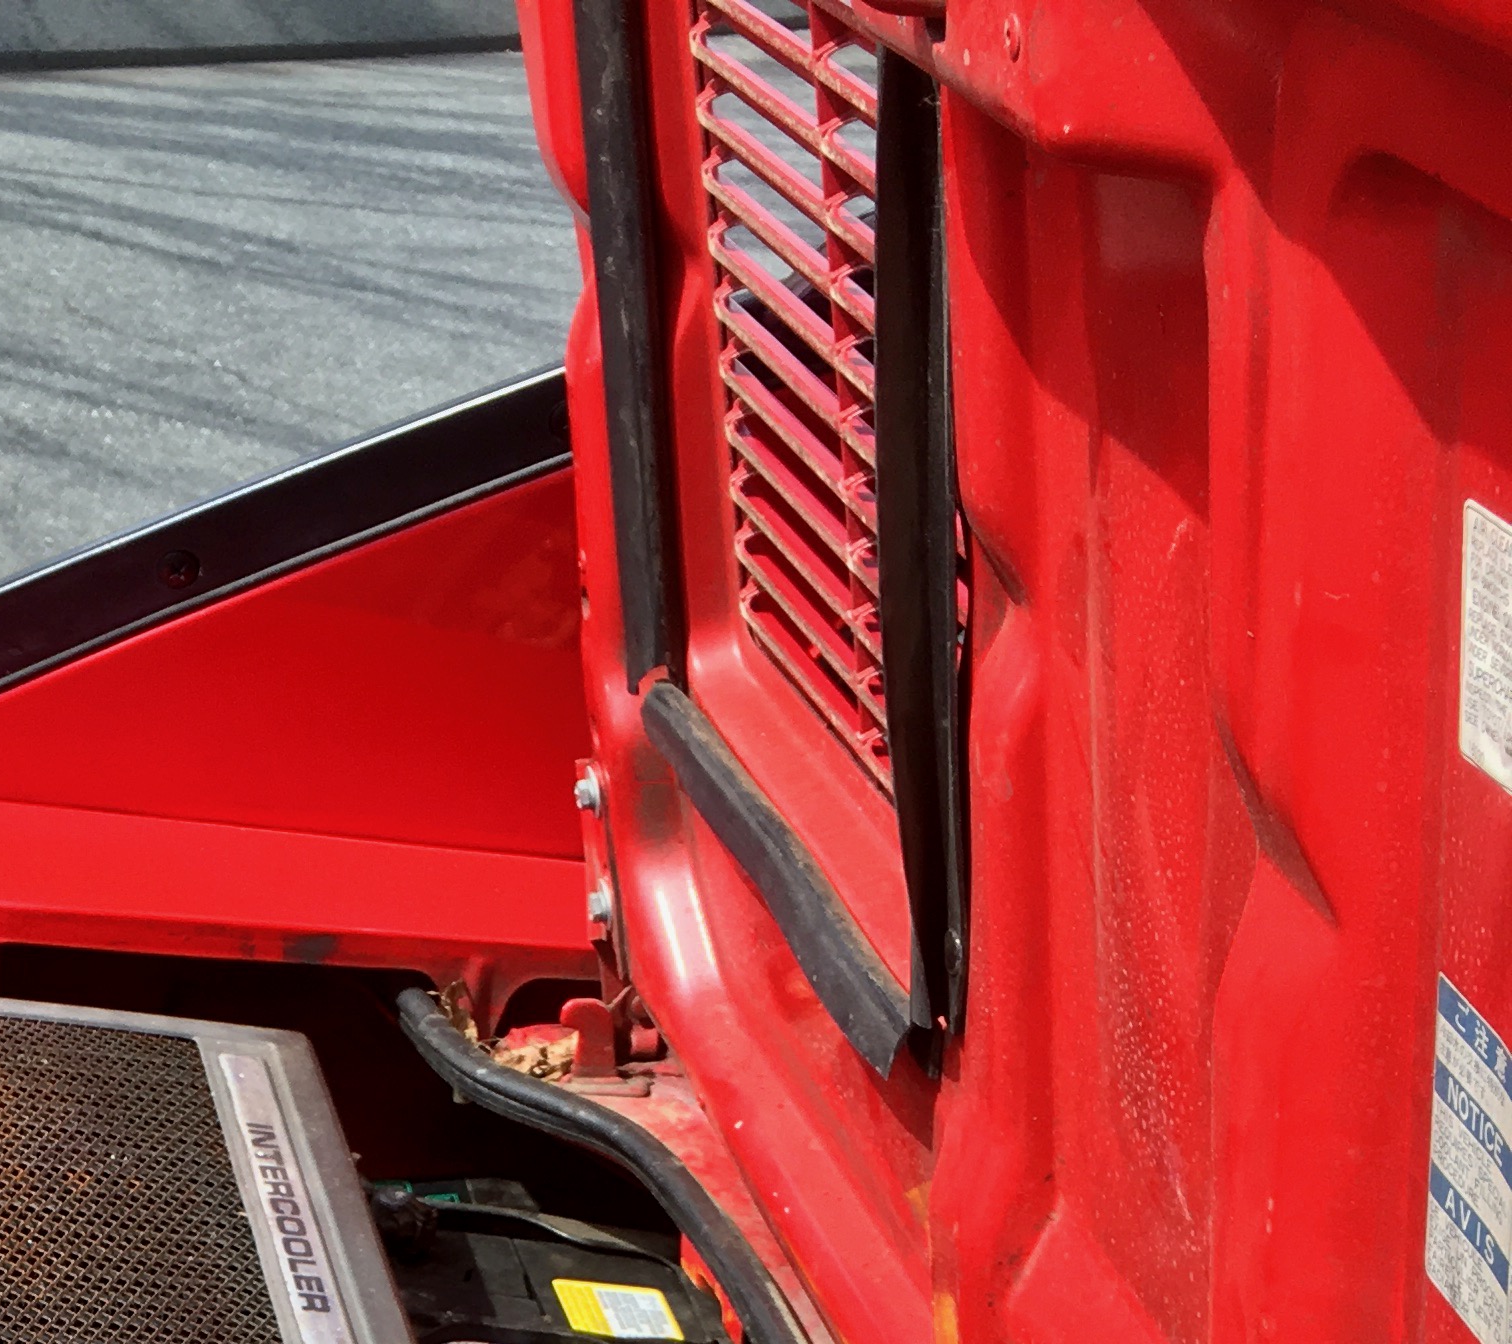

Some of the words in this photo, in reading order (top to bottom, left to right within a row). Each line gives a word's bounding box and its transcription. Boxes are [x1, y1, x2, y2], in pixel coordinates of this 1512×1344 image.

[1447, 1076, 1504, 1168] NOTICE
[245, 1121, 331, 1315] INTERCOOLER
[1445, 1187, 1495, 1265] AVIS
